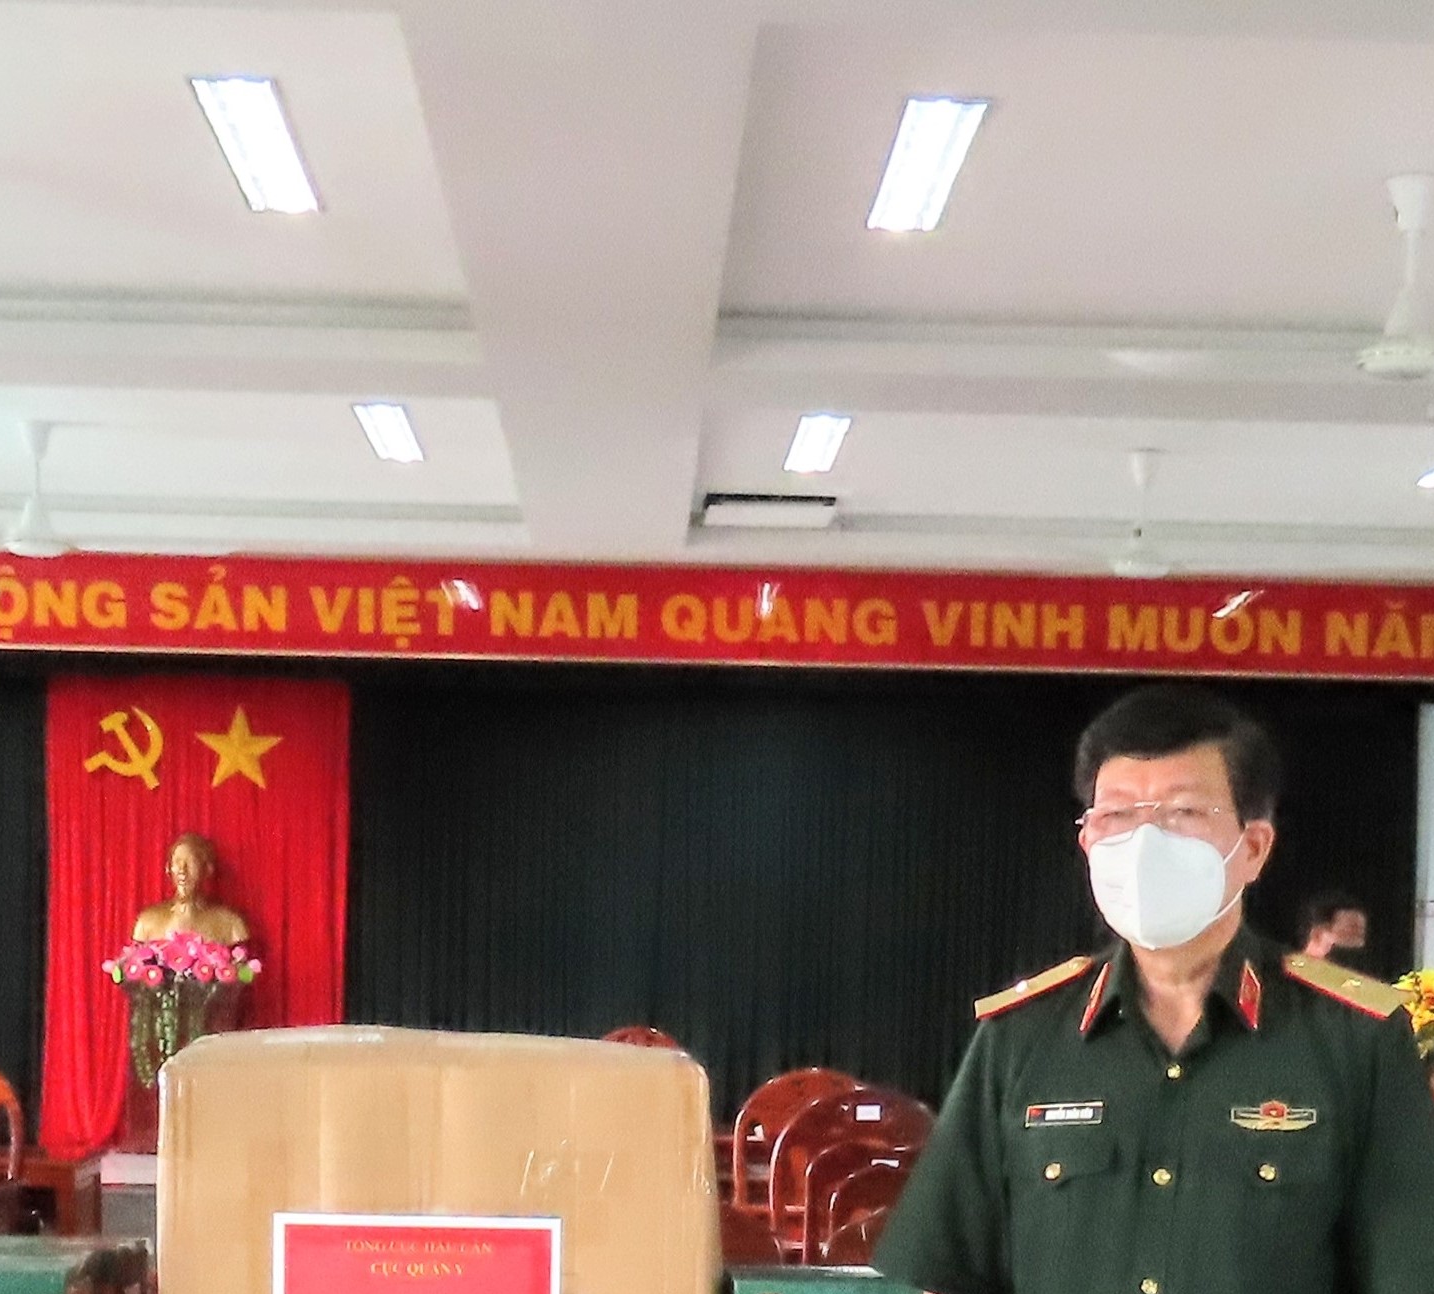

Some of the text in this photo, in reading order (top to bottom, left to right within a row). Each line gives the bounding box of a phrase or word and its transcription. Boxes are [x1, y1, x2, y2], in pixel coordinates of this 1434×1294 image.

[149, 565, 287, 632] SẢN
[310, 576, 461, 648] VIỆT
[490, 590, 638, 639] NAM
[661, 592, 897, 645] QUANG
[922, 601, 1085, 650] VINH
